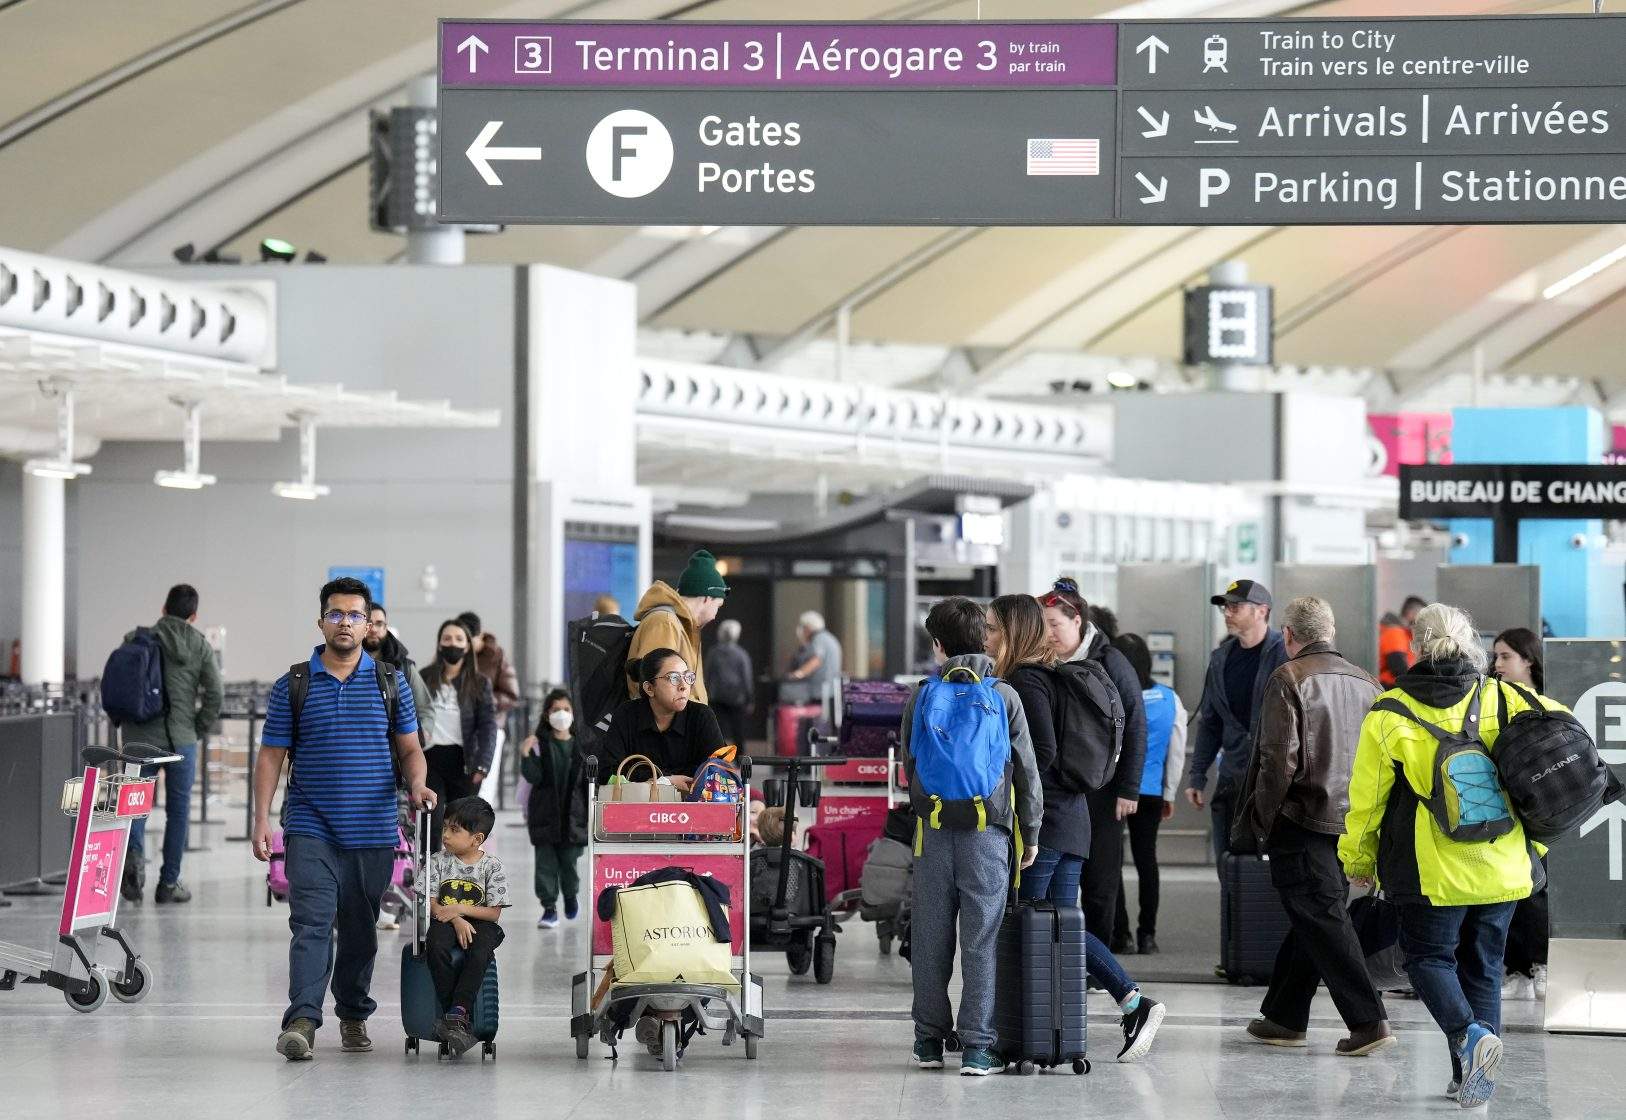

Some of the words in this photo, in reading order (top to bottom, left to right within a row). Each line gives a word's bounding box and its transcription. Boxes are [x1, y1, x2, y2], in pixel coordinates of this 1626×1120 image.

[1009, 41, 1025, 56] by
[1029, 42, 1060, 54] train
[1259, 30, 1314, 50] Train
[1321, 30, 1344, 50] to
[1351, 29, 1396, 53] City
[523, 42, 542, 69] 3
[575, 40, 729, 71] Terminal
[743, 40, 764, 72] 3
[795, 38, 963, 79] Aérogare
[975, 40, 998, 71] 3
[1009, 60, 1029, 75] par
[1033, 59, 1066, 73] train
[1259, 56, 1314, 76] Train
[1321, 60, 1368, 76] vers
[1376, 56, 1395, 76] le
[1402, 54, 1530, 75] centre-ville
[698, 115, 801, 147] Gates
[1258, 105, 1407, 138] Arrivals
[1444, 101, 1609, 136] Arrivées
[611, 125, 648, 182] F
[698, 162, 816, 193] Portes
[1199, 167, 1231, 208] P
[1254, 170, 1397, 210] Parking
[1441, 169, 1626, 202] Stationne
[1410, 480, 1504, 503] BUREAU
[1510, 480, 1542, 503] DE
[649, 812, 678, 824] CIBC
[604, 868, 623, 879] Un
